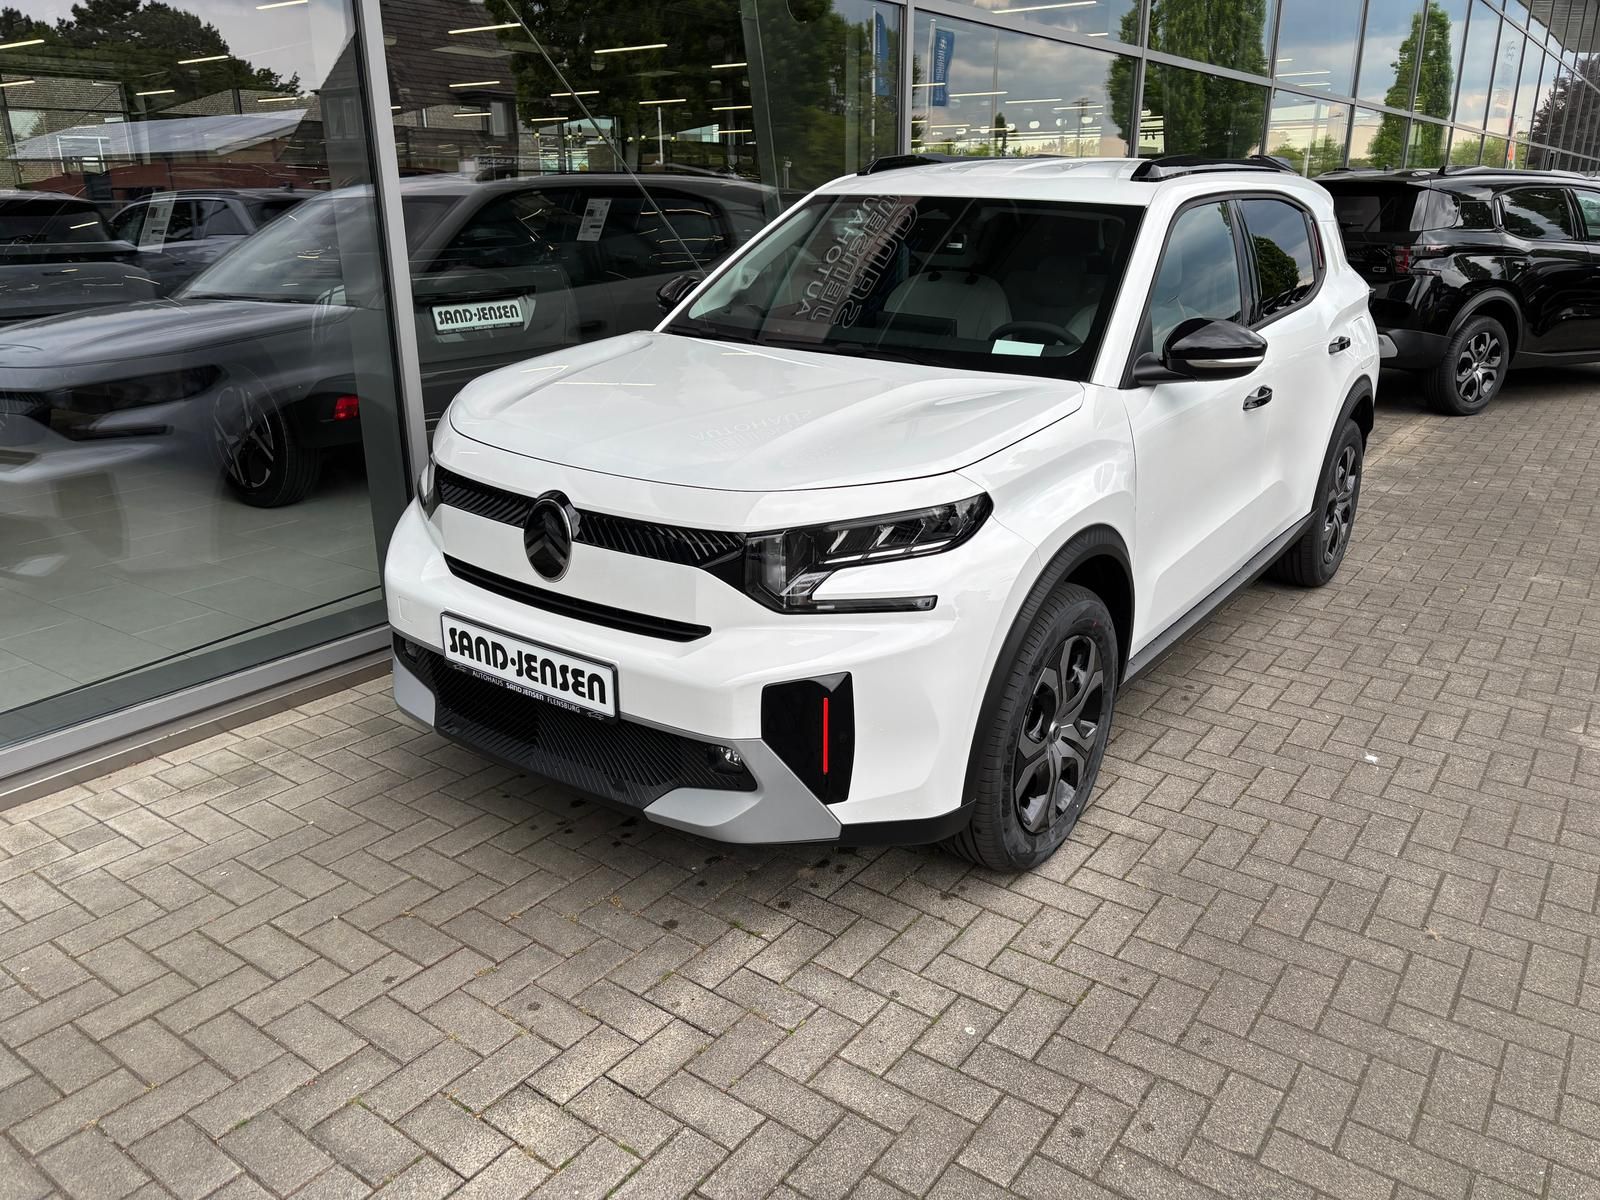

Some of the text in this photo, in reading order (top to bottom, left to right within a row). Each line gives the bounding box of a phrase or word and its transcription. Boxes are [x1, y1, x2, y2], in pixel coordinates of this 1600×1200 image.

[472, 670, 581, 713] AUTOHAUS SAND JENSEN FLENSBURG
